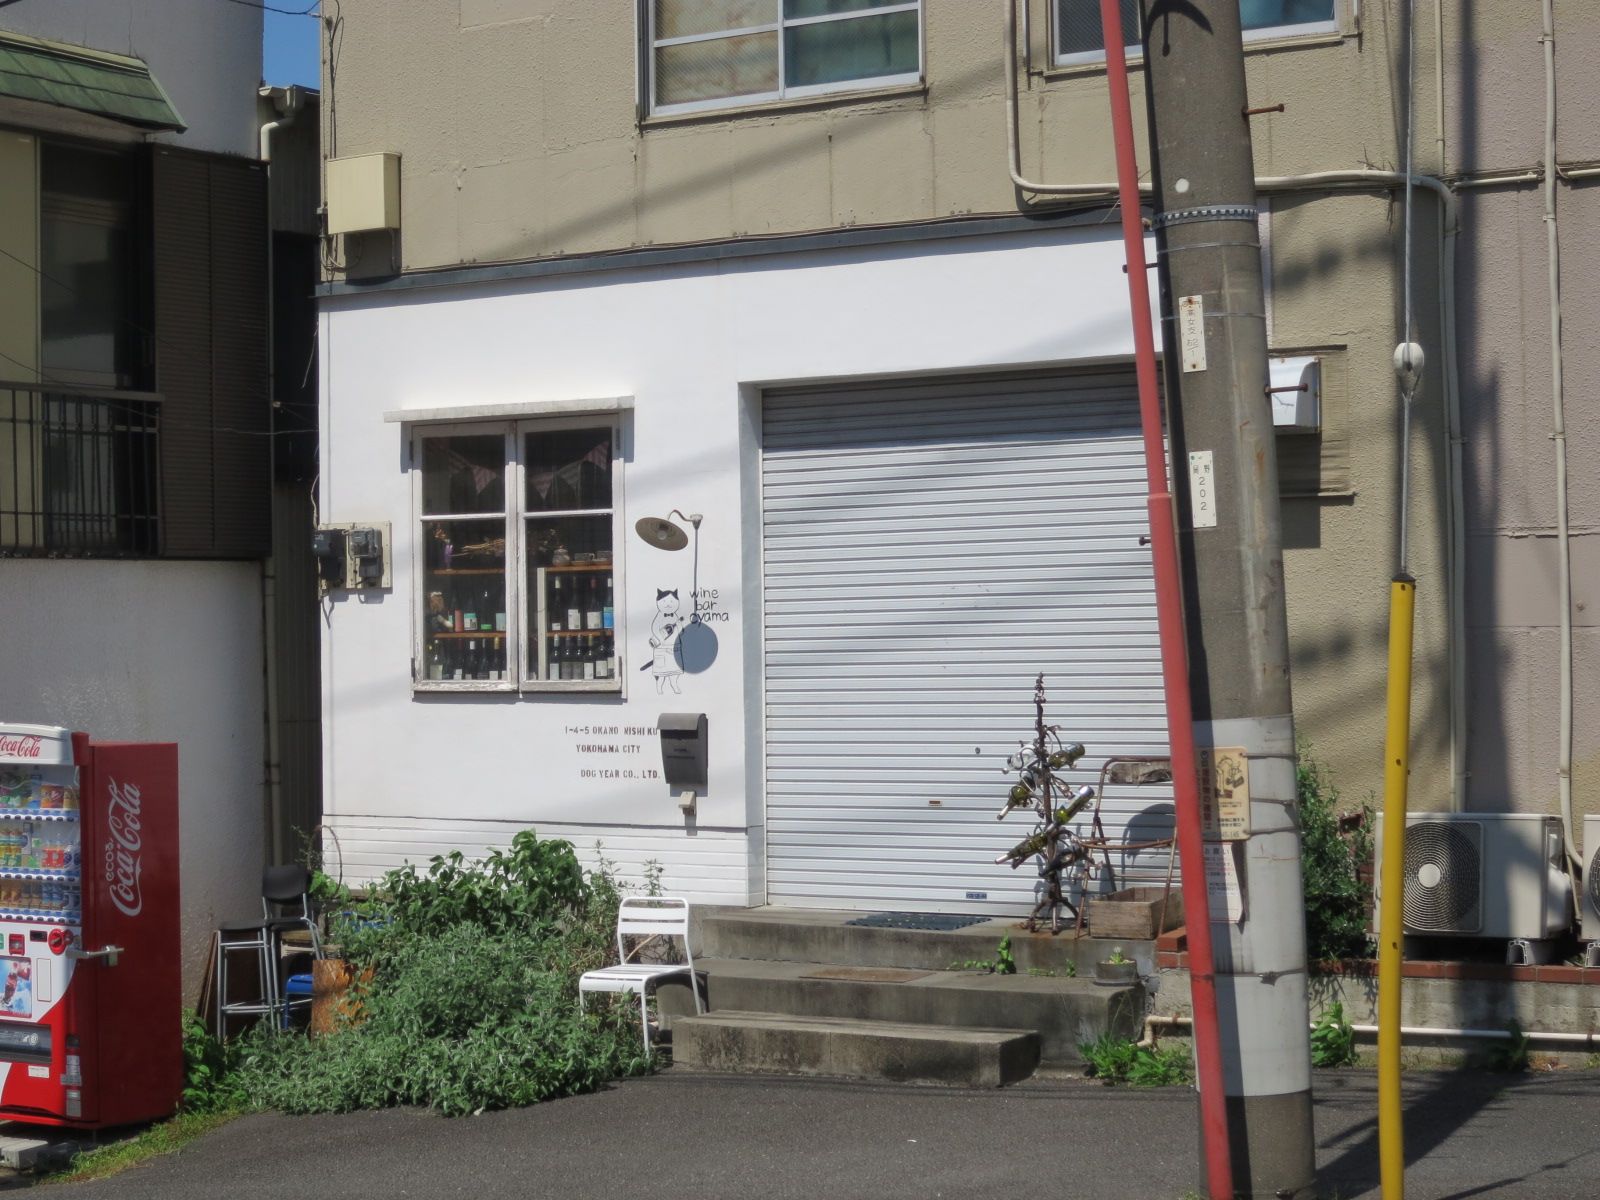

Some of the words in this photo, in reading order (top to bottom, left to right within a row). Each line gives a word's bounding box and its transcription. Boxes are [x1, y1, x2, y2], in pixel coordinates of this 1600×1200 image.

[1199, 476, 1208, 511] 202
[689, 587, 720, 599] wine
[695, 600, 718, 611] bar
[689, 612, 729, 628] oyama
[565, 726, 590, 735] 1-4-5
[592, 726, 619, 735] OKANO
[624, 727, 645, 736] NISHI
[647, 727, 658, 736] KU
[576, 744, 620, 753] YOKOHAMA
[622, 745, 641, 753] CITY
[580, 769, 597, 778] DOG
[599, 770, 620, 779] YEAR
[108, 776, 143, 917] Coca-Cola
